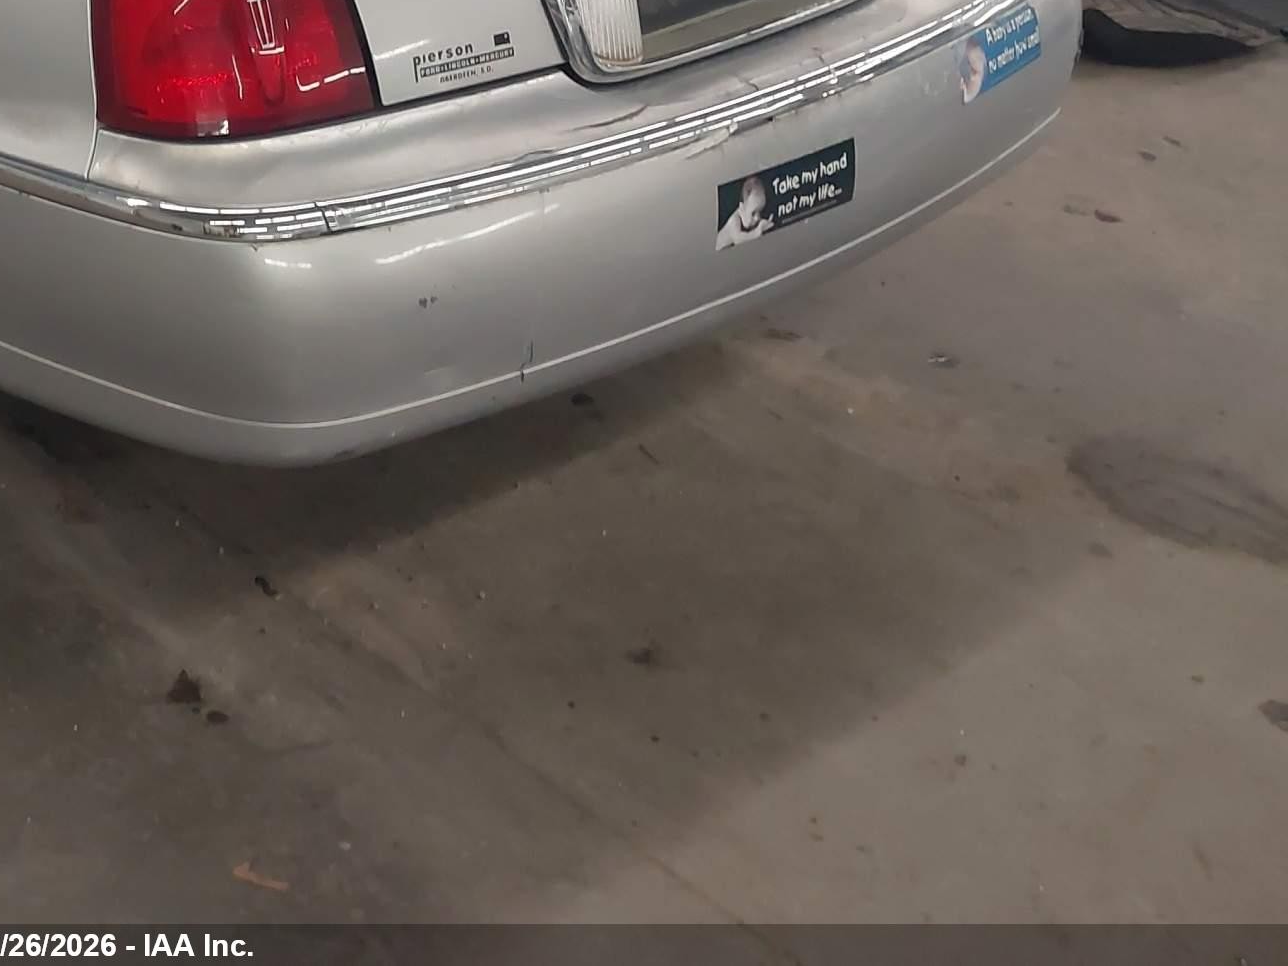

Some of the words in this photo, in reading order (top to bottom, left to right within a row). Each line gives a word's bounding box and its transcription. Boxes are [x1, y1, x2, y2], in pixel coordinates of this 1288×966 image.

[772, 174, 800, 195] Take
[802, 168, 818, 185] my
[820, 152, 847, 177] hand
[778, 196, 798, 217] not
[799, 191, 816, 208] my
